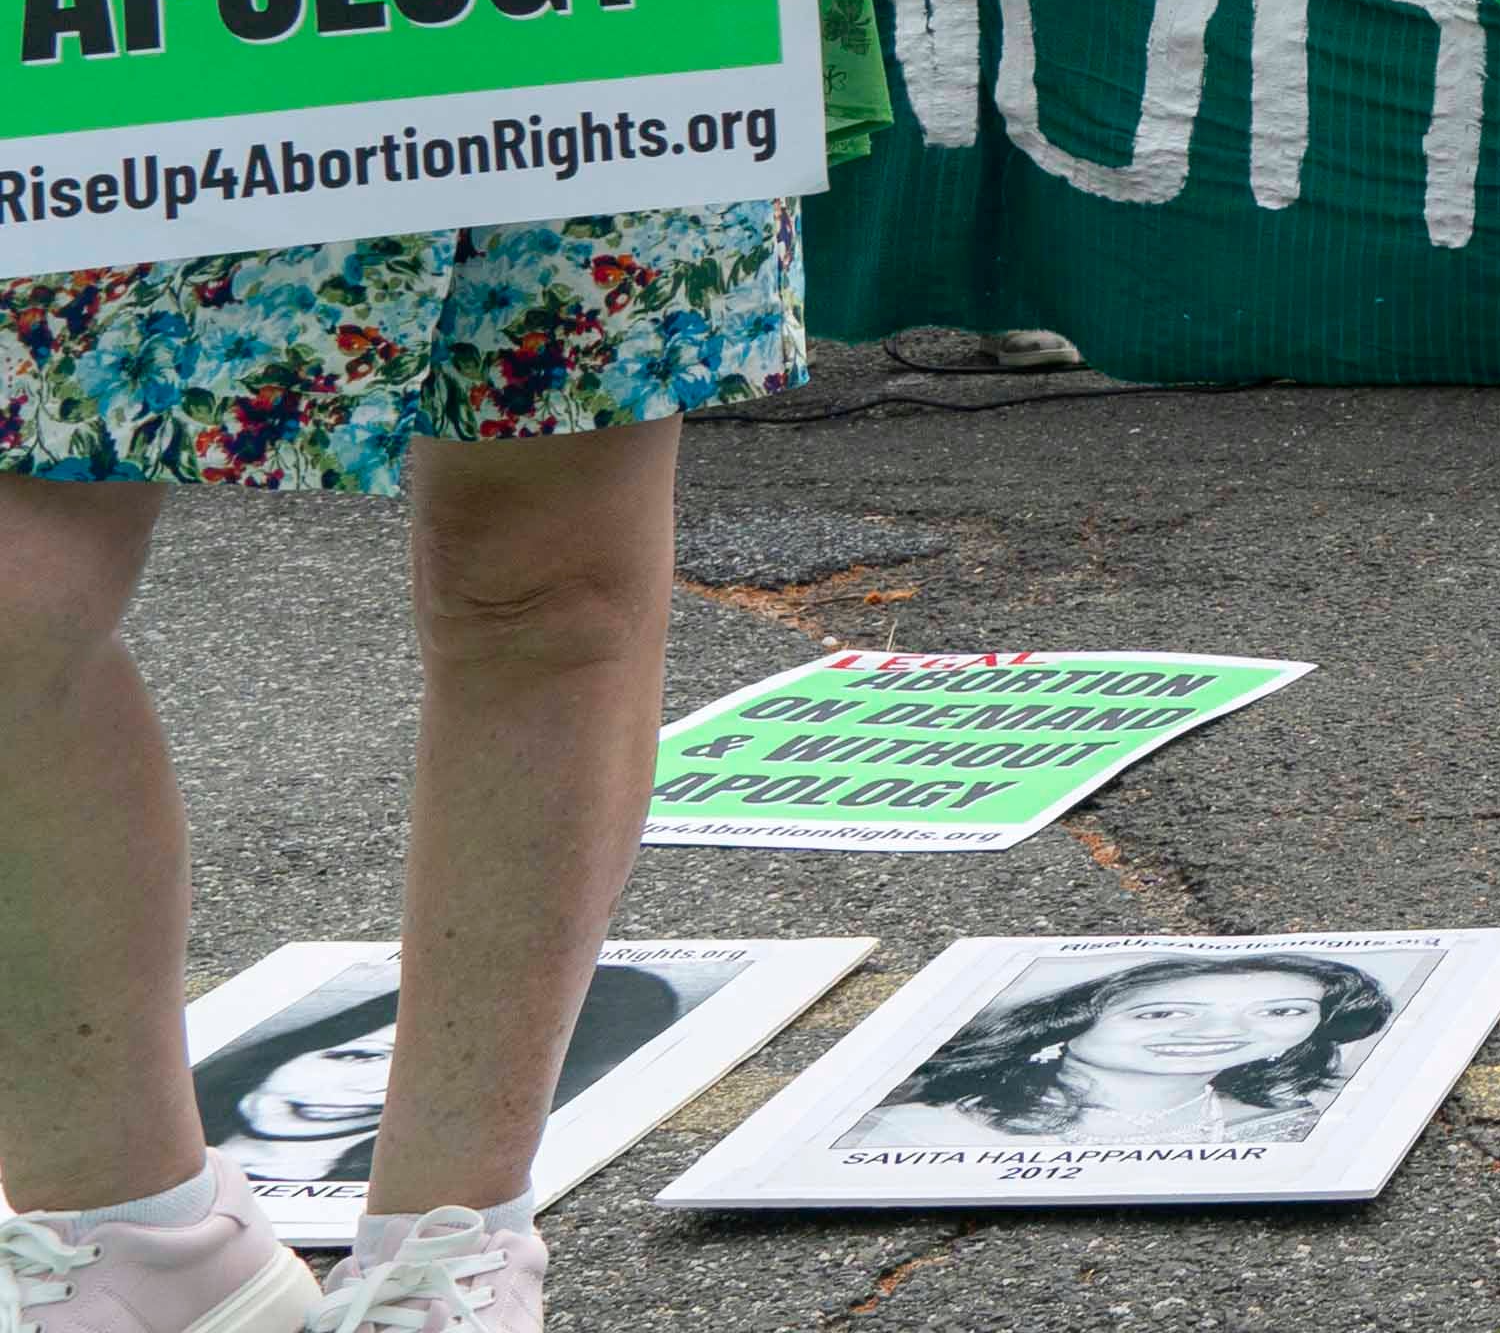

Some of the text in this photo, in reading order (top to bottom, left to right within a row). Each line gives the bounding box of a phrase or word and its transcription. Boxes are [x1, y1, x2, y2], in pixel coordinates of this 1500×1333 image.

[823, 651, 1051, 671] LEGAL
[844, 669, 1221, 699] ABORTION
[738, 695, 1200, 734] ON DEMAND
[680, 733, 1120, 771] & WITHOUT
[650, 772, 1023, 812] APOLOGY
[842, 1146, 1268, 1166] SAVITA HALAPPANAVAR
[998, 1165, 1084, 1181] 2012
